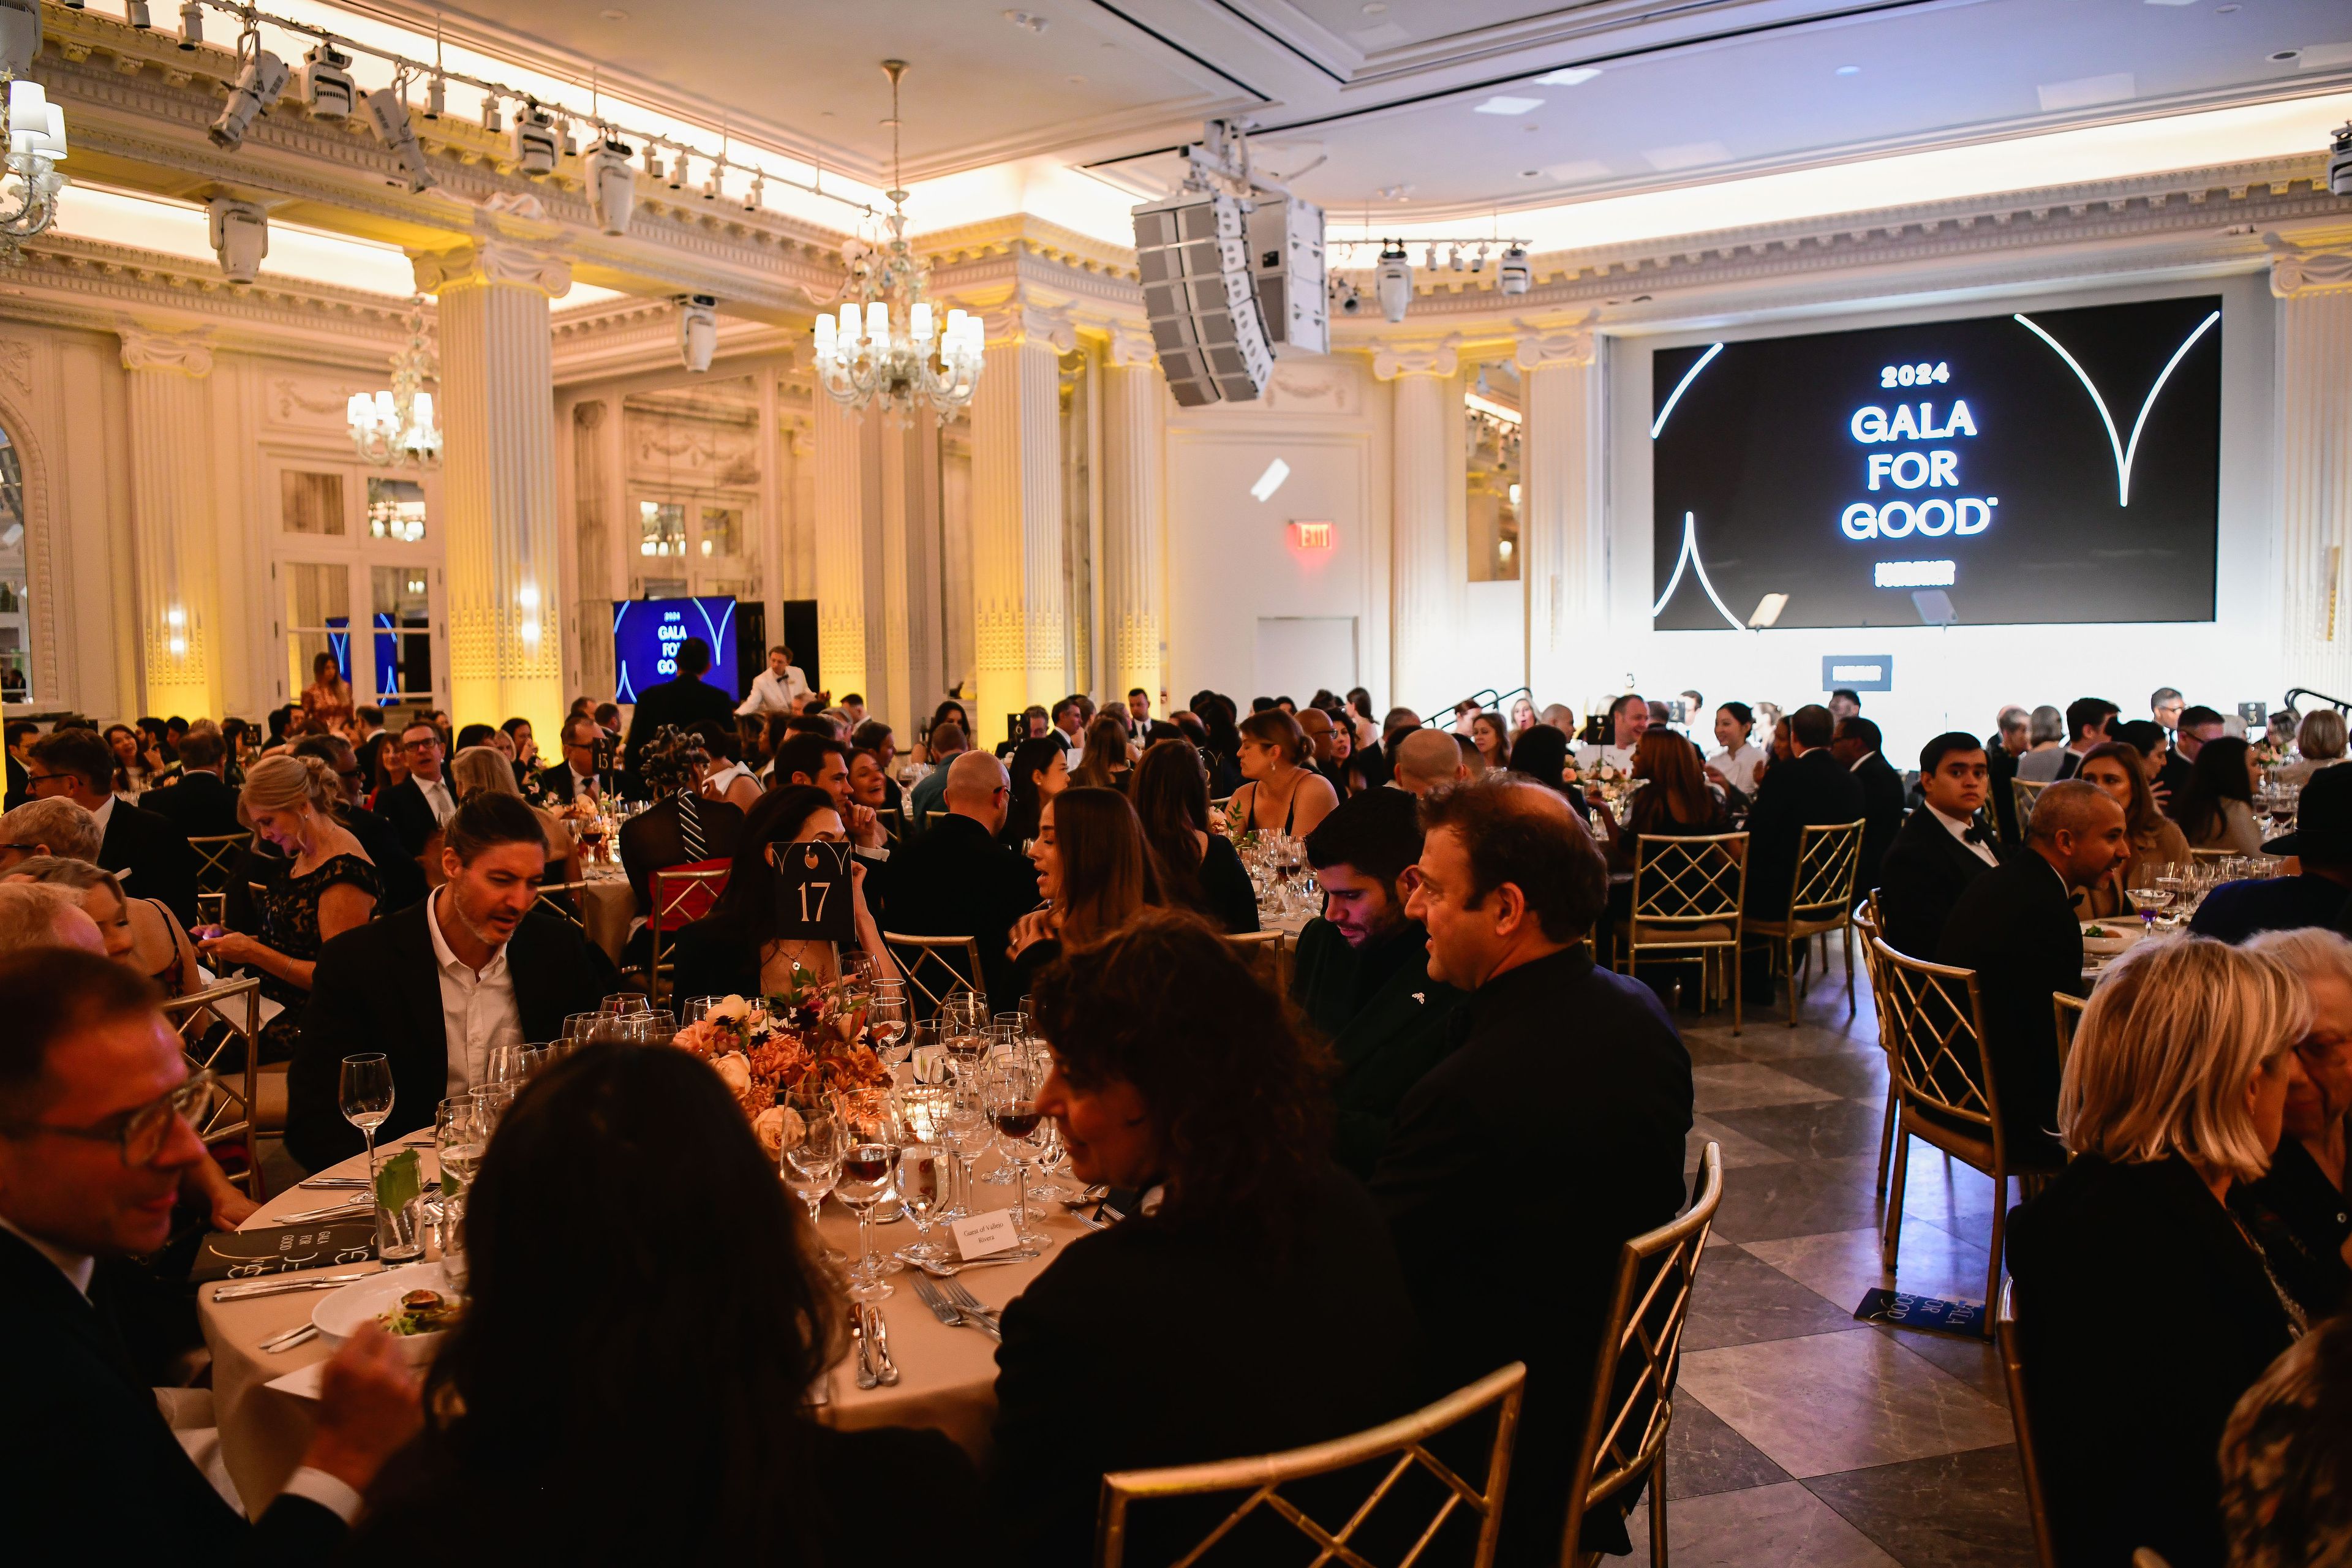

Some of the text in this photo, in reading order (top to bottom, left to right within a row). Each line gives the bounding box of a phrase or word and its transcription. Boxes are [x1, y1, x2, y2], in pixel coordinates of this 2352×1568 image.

[1881, 362, 1950, 388] 2024
[1851, 400, 1977, 443] GALA
[1868, 450, 1959, 491] FOR
[1301, 524, 1329, 547] EXIT
[658, 625, 687, 641] GALA
[662, 642, 680, 658] FO
[657, 659, 677, 674] GO
[1597, 726, 1604, 739] 7
[797, 881, 831, 922] 17
[279, 1235, 294, 1250] GOOD
[299, 1235, 312, 1245] FOR
[317, 1231, 331, 1245] GALA
[978, 1235, 995, 1243] Rivera
[1921, 1299, 1946, 1314] OR
